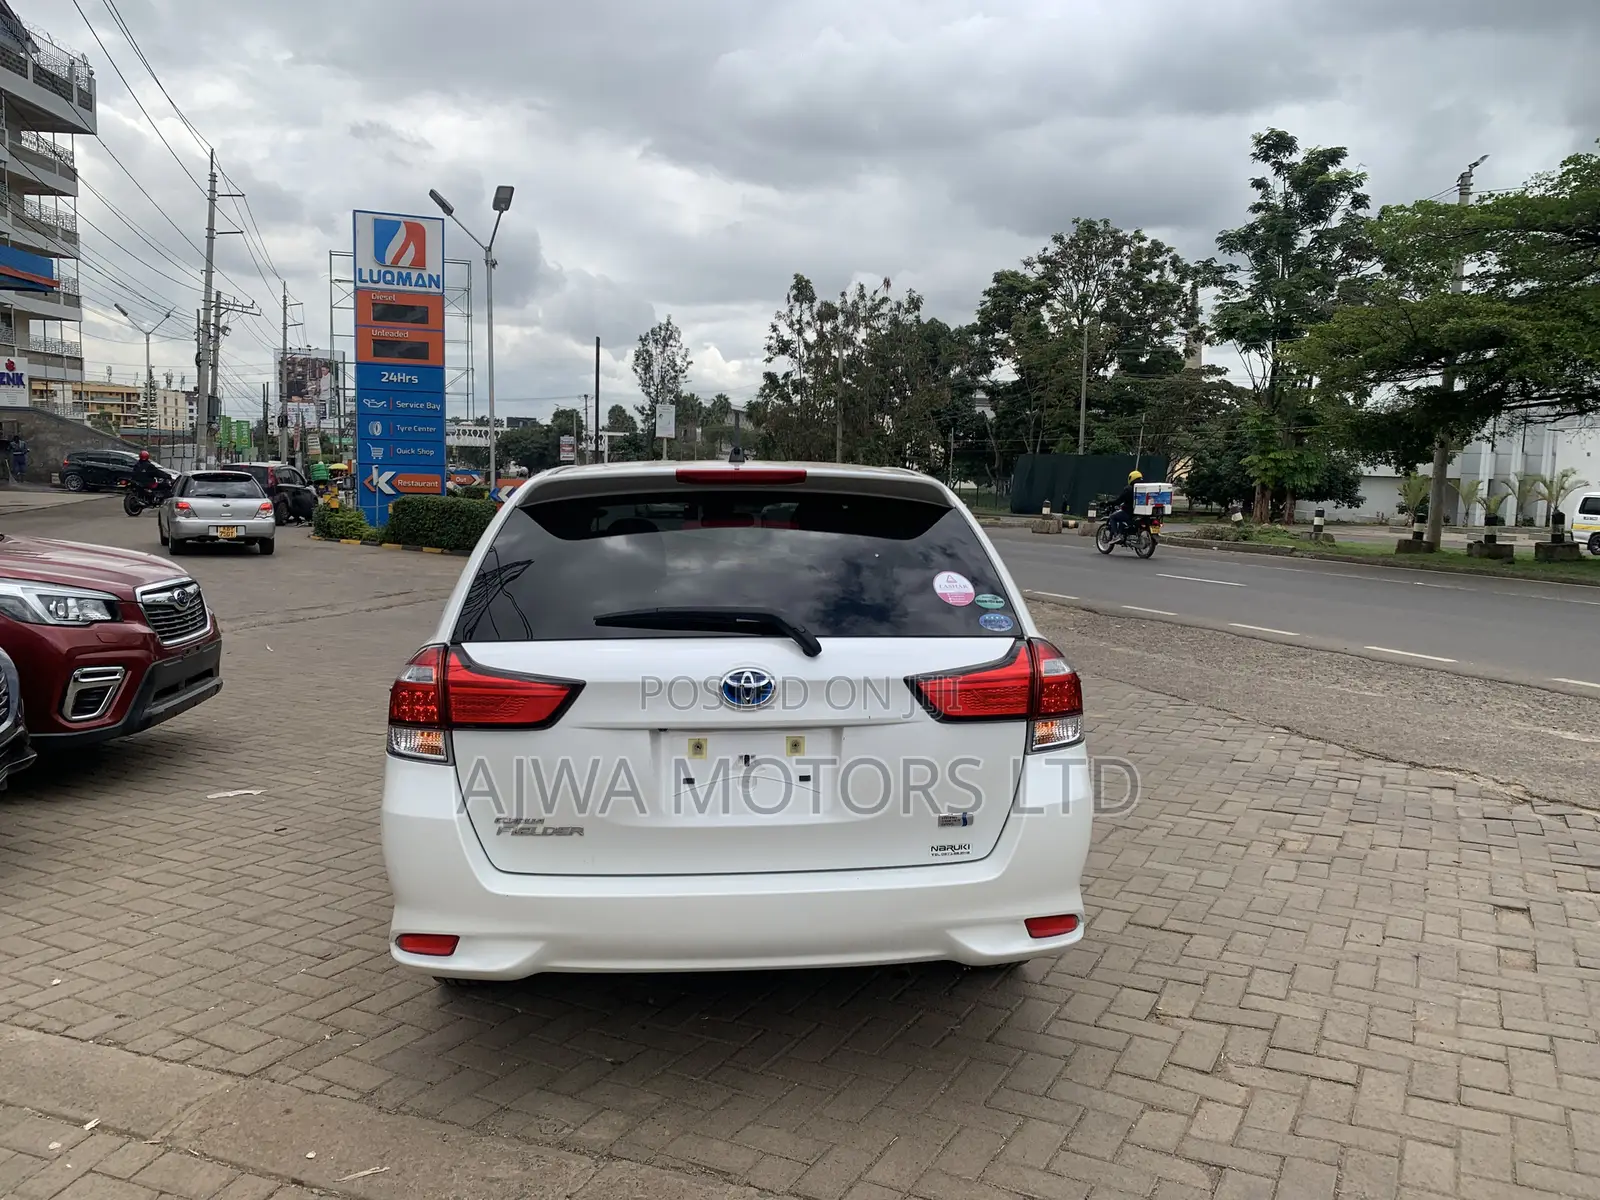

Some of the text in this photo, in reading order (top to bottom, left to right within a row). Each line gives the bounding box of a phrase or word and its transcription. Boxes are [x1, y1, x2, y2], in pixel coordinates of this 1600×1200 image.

[358, 268, 441, 289] LUQMAN
[371, 292, 396, 302] Diesel
[371, 329, 409, 338] Unleaded
[380, 371, 419, 384] 24Hrs
[396, 400, 441, 411] Service Bay
[396, 424, 412, 433] Tyre
[396, 447, 435, 456] Quick Shop
[397, 479, 439, 488] Restaurant
